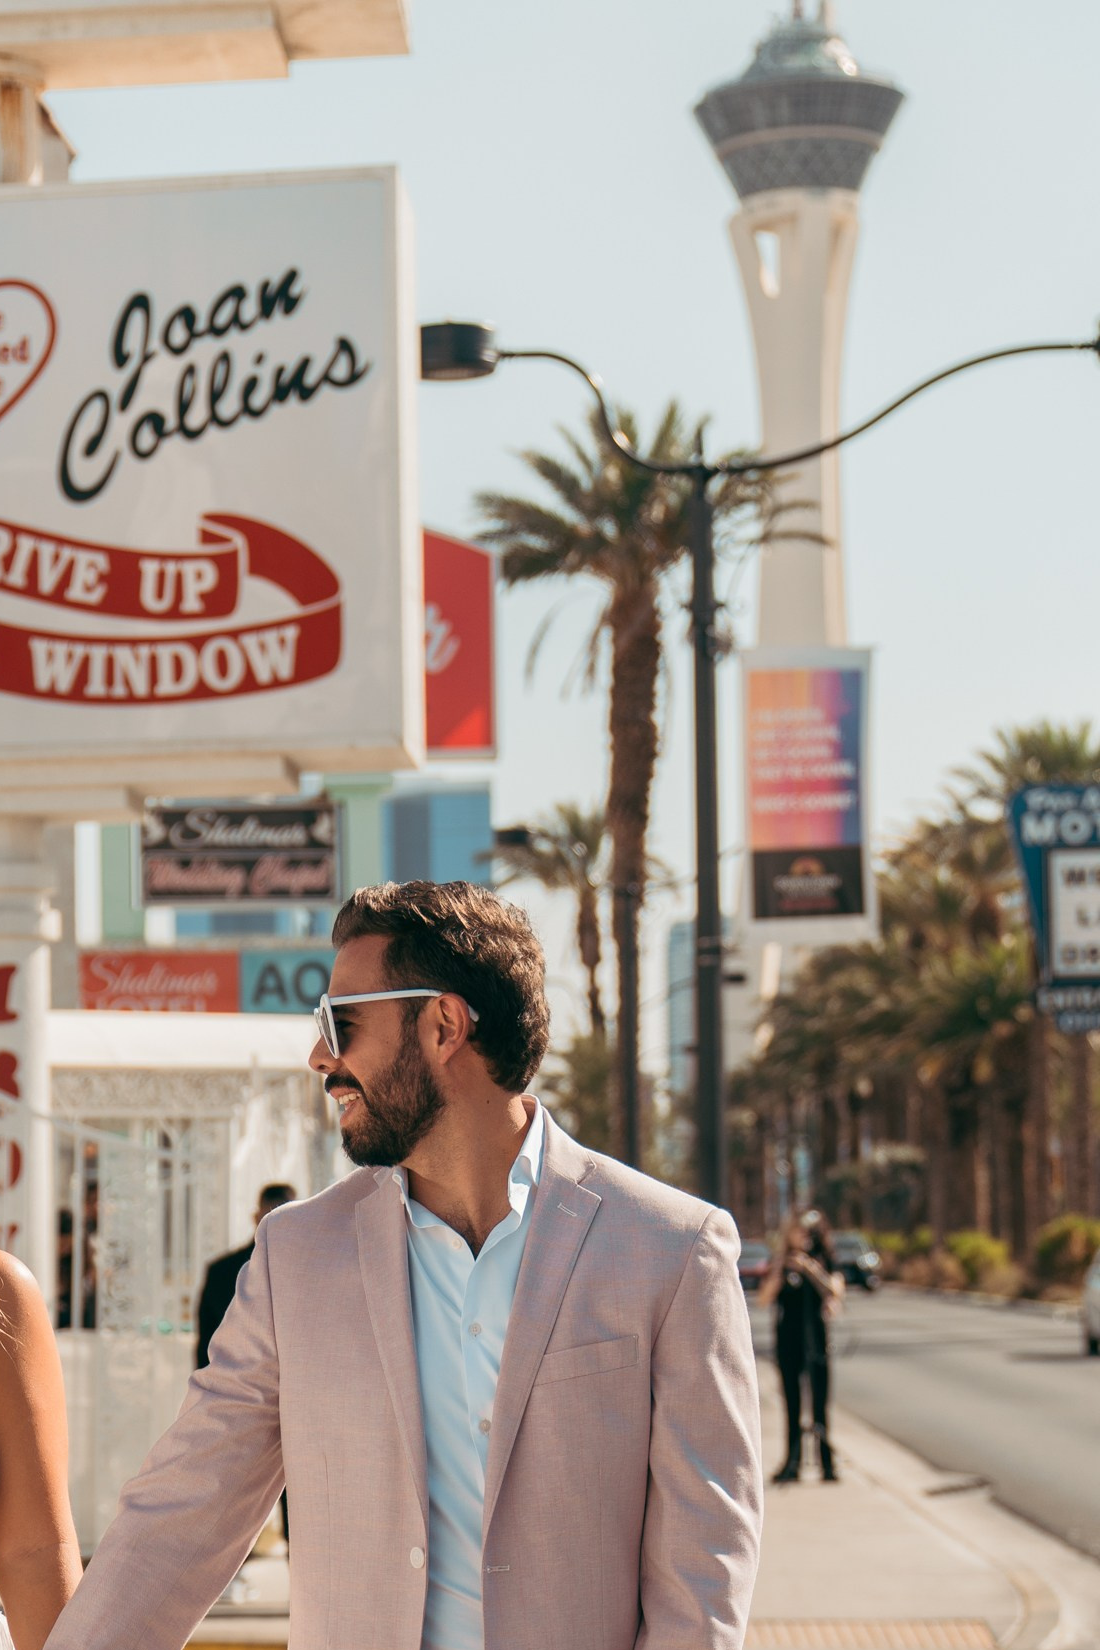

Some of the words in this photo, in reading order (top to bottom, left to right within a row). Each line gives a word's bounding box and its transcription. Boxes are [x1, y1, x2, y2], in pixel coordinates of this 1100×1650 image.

[110, 267, 305, 412] Joan
[58, 336, 372, 503] Collins
[139, 558, 218, 615] UP
[27, 624, 301, 698] WINDOW
